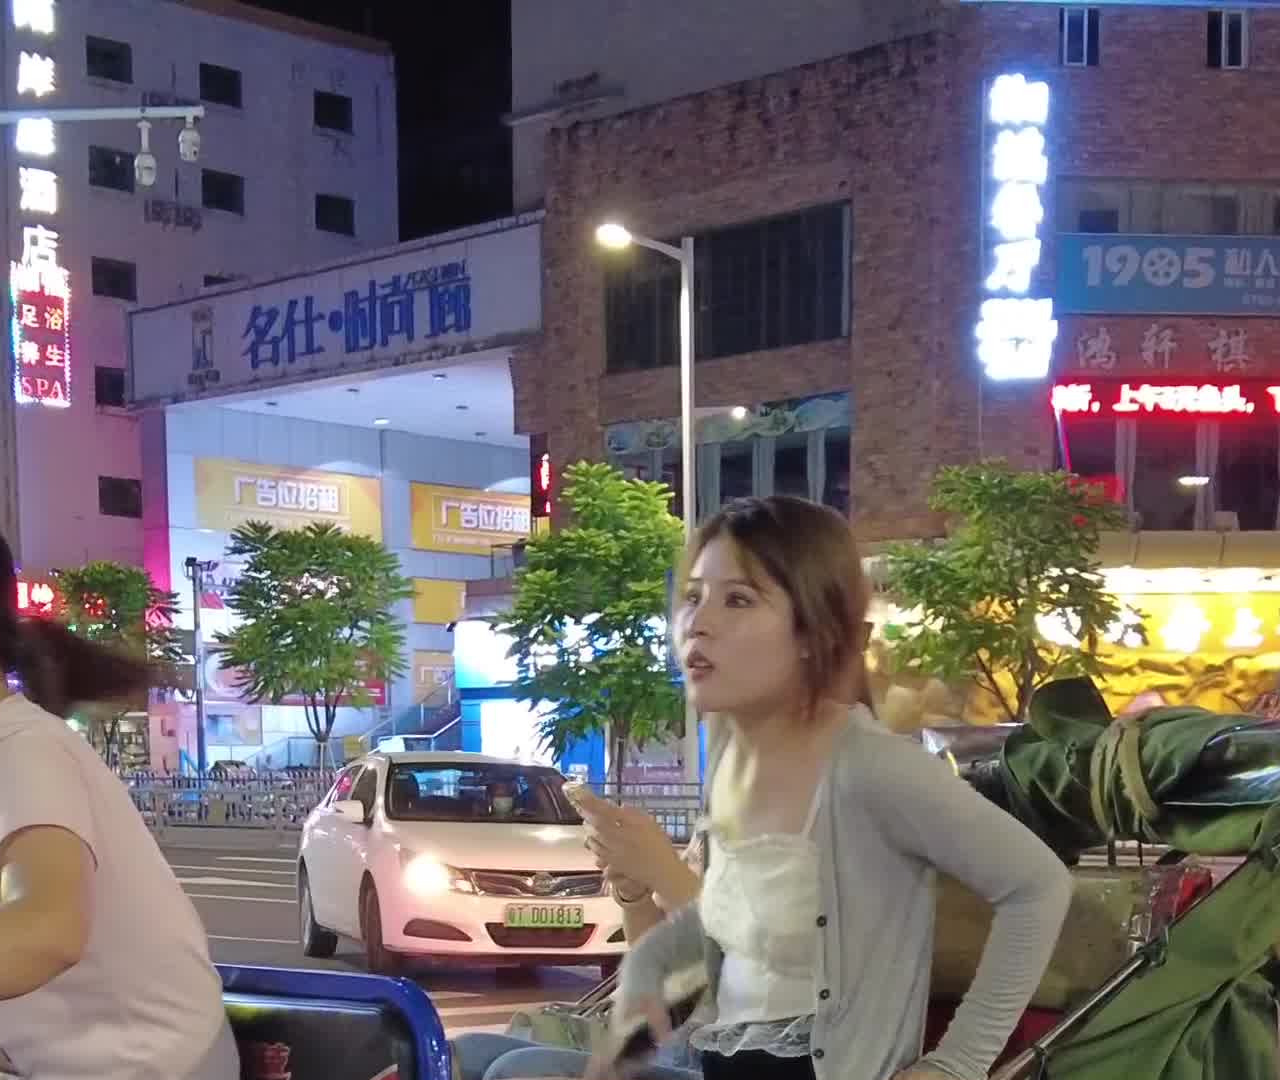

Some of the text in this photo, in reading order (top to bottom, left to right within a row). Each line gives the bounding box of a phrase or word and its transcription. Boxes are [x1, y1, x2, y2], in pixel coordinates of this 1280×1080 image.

[1081, 245, 1217, 288] 1905
[21, 303, 64, 331] 足浴
[21, 376, 64, 400] SPA
[234, 477, 341, 514] 广告位招租
